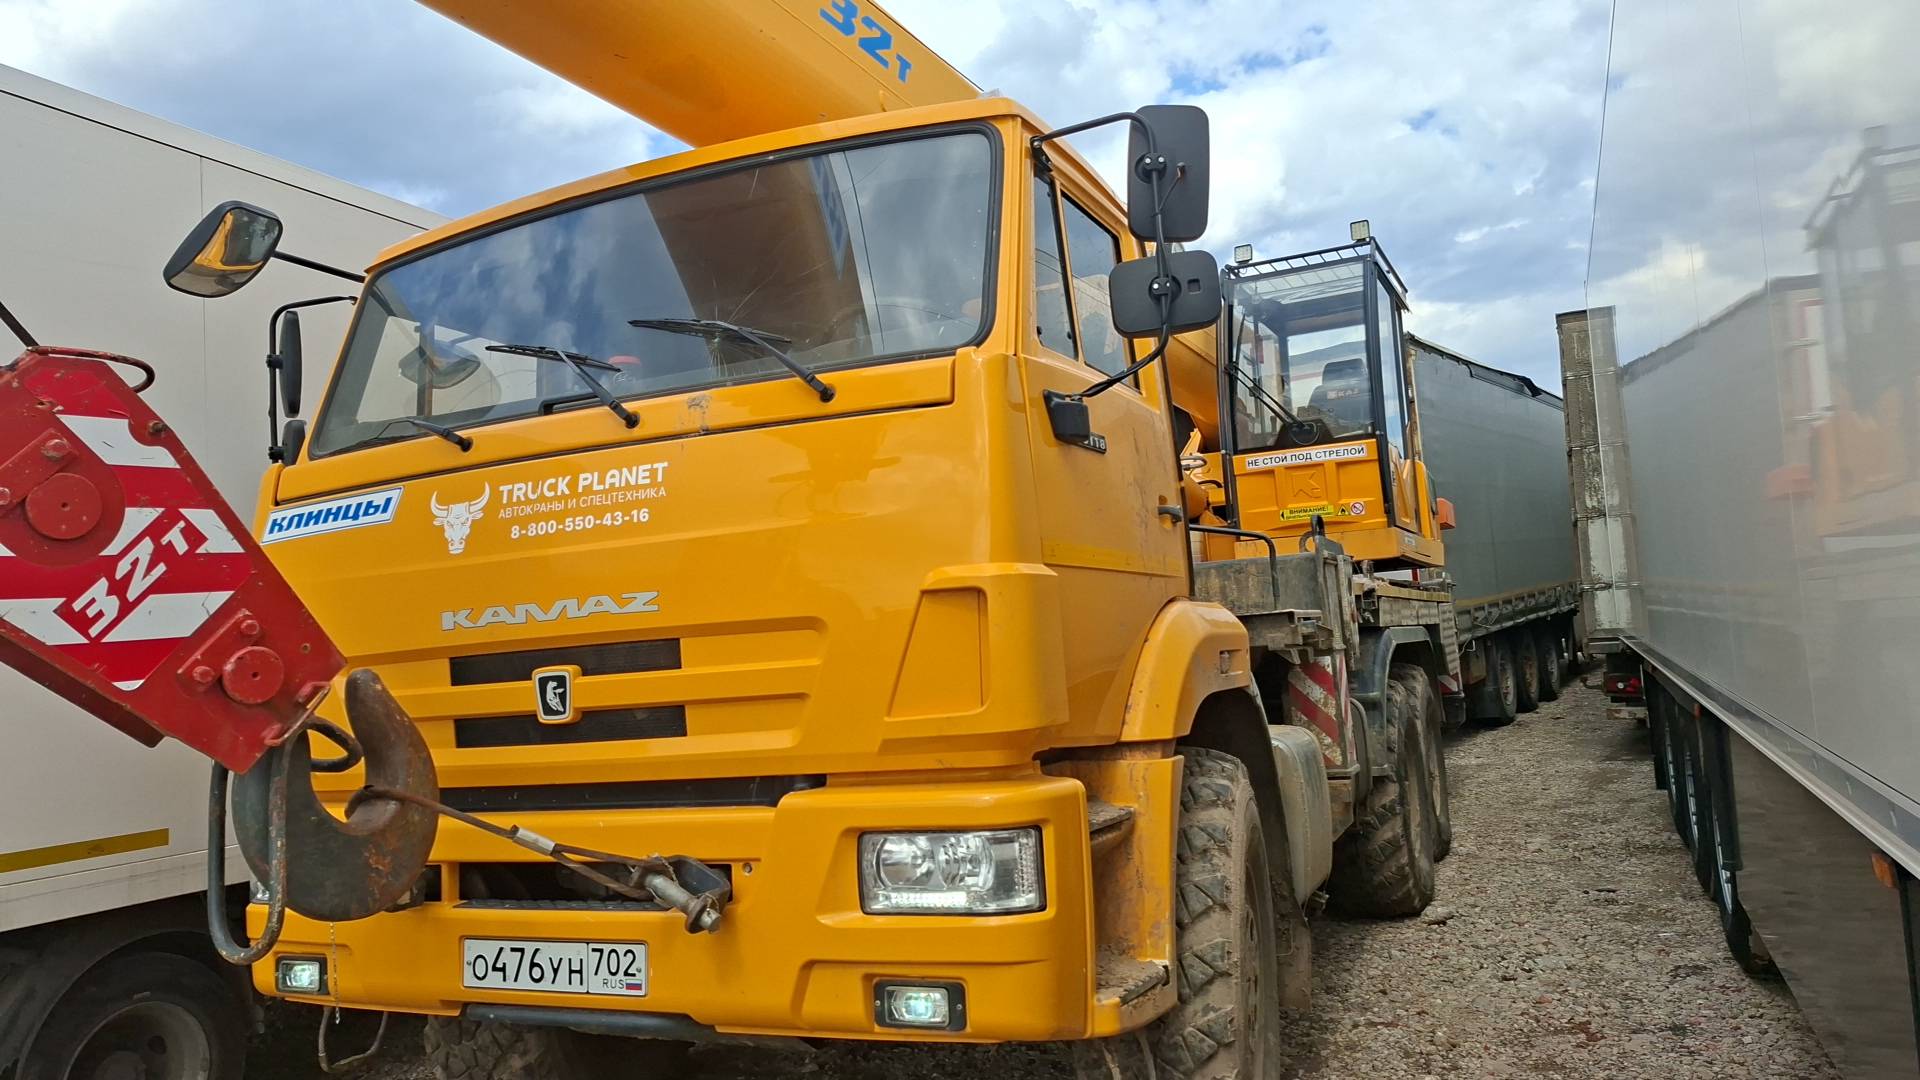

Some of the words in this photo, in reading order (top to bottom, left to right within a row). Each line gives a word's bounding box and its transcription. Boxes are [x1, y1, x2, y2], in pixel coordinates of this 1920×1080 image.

[1247, 459, 1260, 468] НЕ
[1290, 452, 1312, 462] ПОД
[498, 475, 572, 504] TRUCK
[577, 461, 669, 493] PLANET
[268, 496, 393, 535] КЛИНЦЫ
[498, 500, 565, 519] АВТОКРАНЫ
[567, 498, 577, 509] И
[580, 486, 667, 508] СПЕЦТЕХНИКА
[511, 508, 649, 539] 8-800-550-43-16
[440, 591, 660, 631] KAMAZ
[591, 948, 637, 977] 702
[602, 978, 625, 989] RUS
